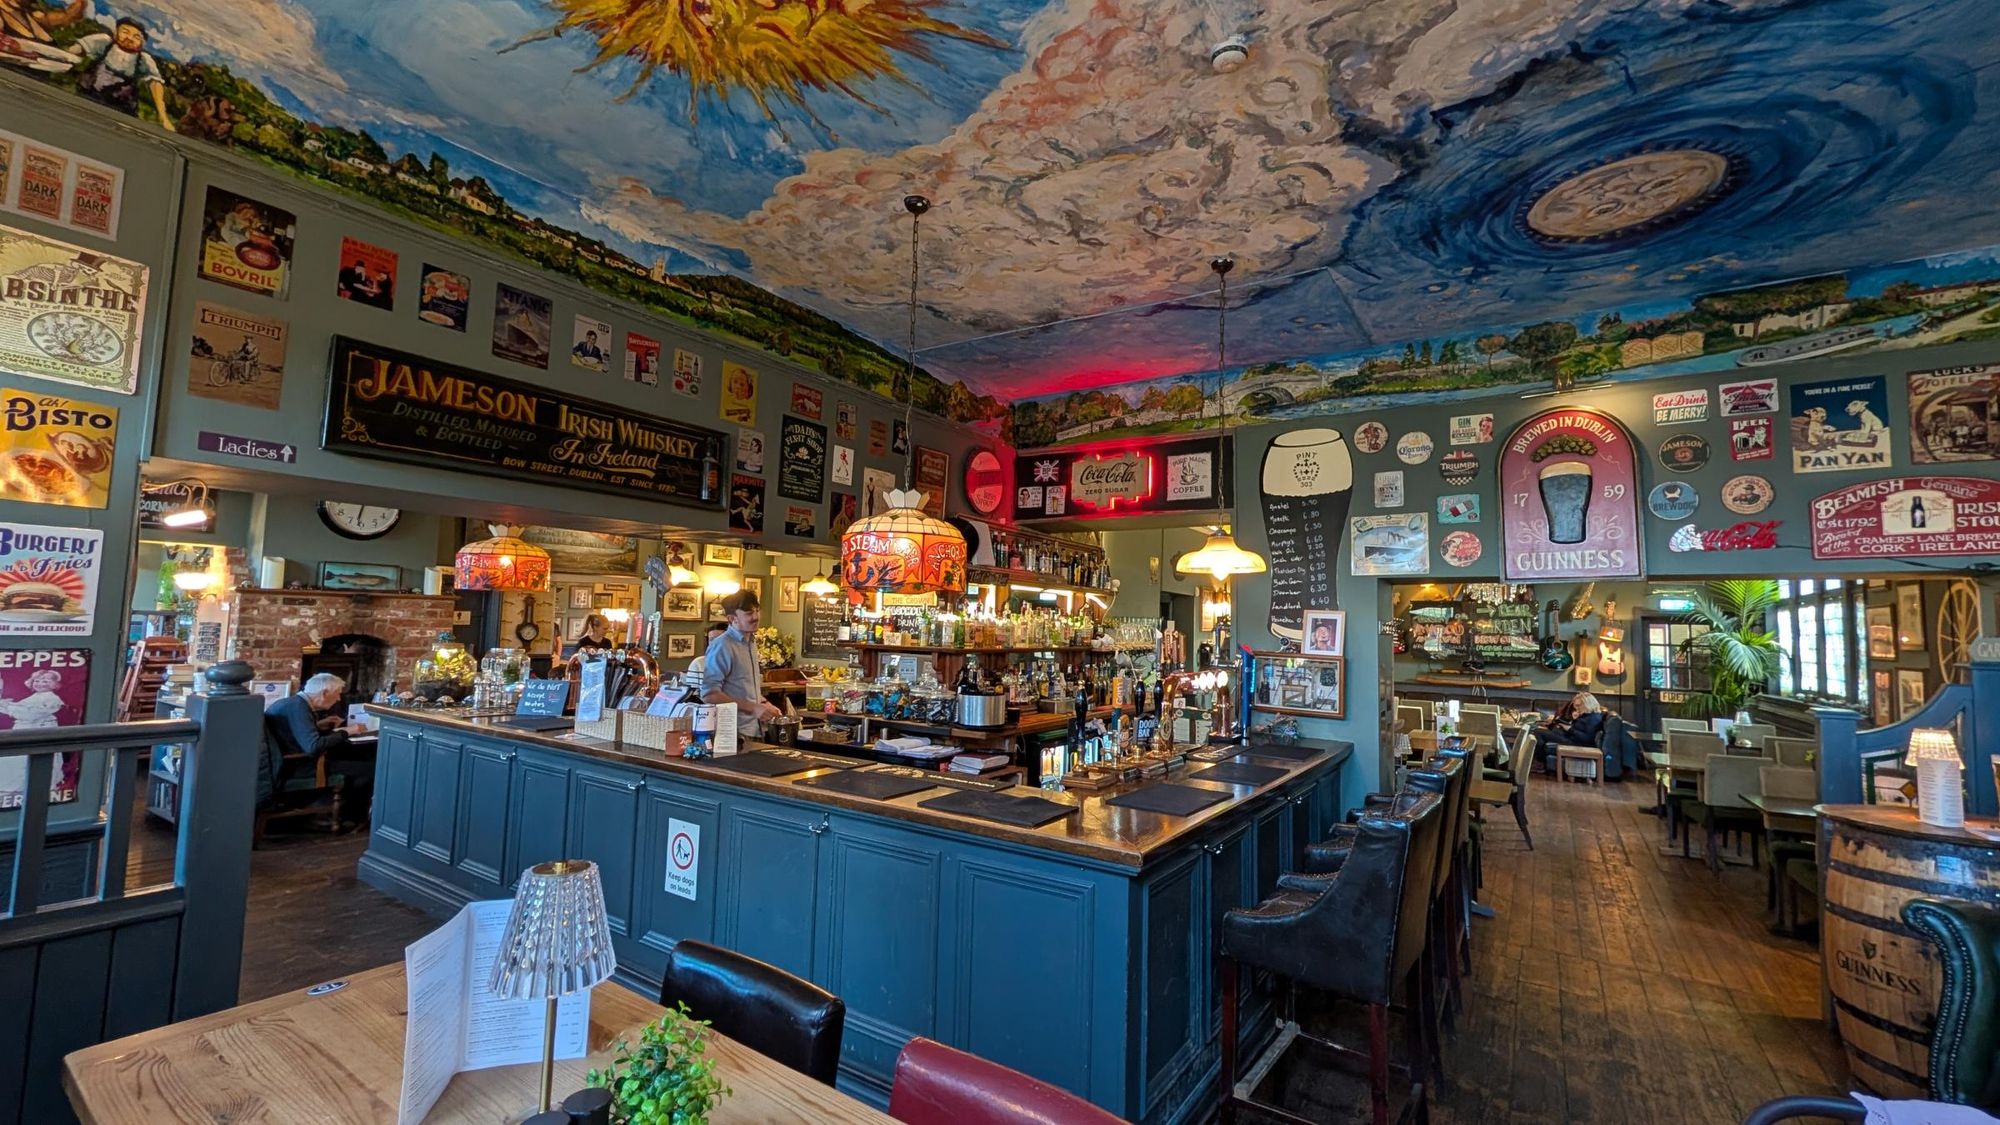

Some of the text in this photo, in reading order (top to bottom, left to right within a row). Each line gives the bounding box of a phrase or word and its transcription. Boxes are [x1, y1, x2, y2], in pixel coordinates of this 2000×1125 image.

[24, 180, 58, 201] DARK
[77, 196, 109, 217] DARK
[212, 263, 276, 289] BOVRIL
[0, 276, 141, 313] BSINTHE
[207, 311, 276, 337] TRIUMPH
[357, 359, 538, 425] JAMESON
[1655, 393, 1706, 408] Eat Drink
[5, 397, 112, 431] BISTO
[1656, 405, 1707, 422] BE MERRY!
[475, 417, 537, 443] MATURED
[1458, 417, 1471, 427] GIN
[1732, 418, 1770, 431] BEER
[416, 425, 503, 450] & BOTTLED
[559, 404, 614, 440] IRISH
[617, 418, 699, 460] WHISKEY
[794, 424, 816, 439] DAD'S
[1513, 415, 1617, 454] BREWED IN DUBLIN
[218, 437, 278, 460] Ladies
[806, 438, 824, 454] SHOP
[1399, 445, 1432, 455] Corona
[1662, 440, 1703, 452] JAMESON
[552, 438, 660, 471] In Ireland
[1296, 451, 1318, 460] PINT
[1800, 452, 1884, 468] PAN YAN
[503, 457, 526, 468] BOW
[610, 475, 626, 485] EST
[631, 478, 652, 489] SINCE
[1440, 461, 1479, 470] TRIUMPH
[732, 473, 766, 488] MARMITE
[1173, 485, 1205, 494] COFFEE
[1513, 484, 1625, 507] 17 59
[1653, 500, 1697, 512] BREWDOG
[1814, 478, 1979, 519] BEAMISH Genuine
[1816, 517, 1878, 529] Est 1792
[0, 527, 98, 557] BURGERS
[850, 534, 890, 554] STEAM
[1833, 539, 1851, 550] the
[1854, 534, 1915, 545] CRAMERS
[1917, 534, 1955, 543] LANE
[1859, 543, 1906, 553] CORK
[32, 556, 93, 578] Fries
[1516, 549, 1625, 571] GUINNESS
[1271, 601, 1302, 610] Landlord
[14, 624, 34, 632] and
[37, 624, 86, 633] DELICIOUS
[0, 650, 87, 669] EPPES
[527, 681, 563, 691] We do NOT
[1138, 728, 1151, 738] BAR
[668, 871, 695, 887] Keep dogs
[678, 884, 691, 895] leads
[1835, 949, 1921, 996] GUINNESS
